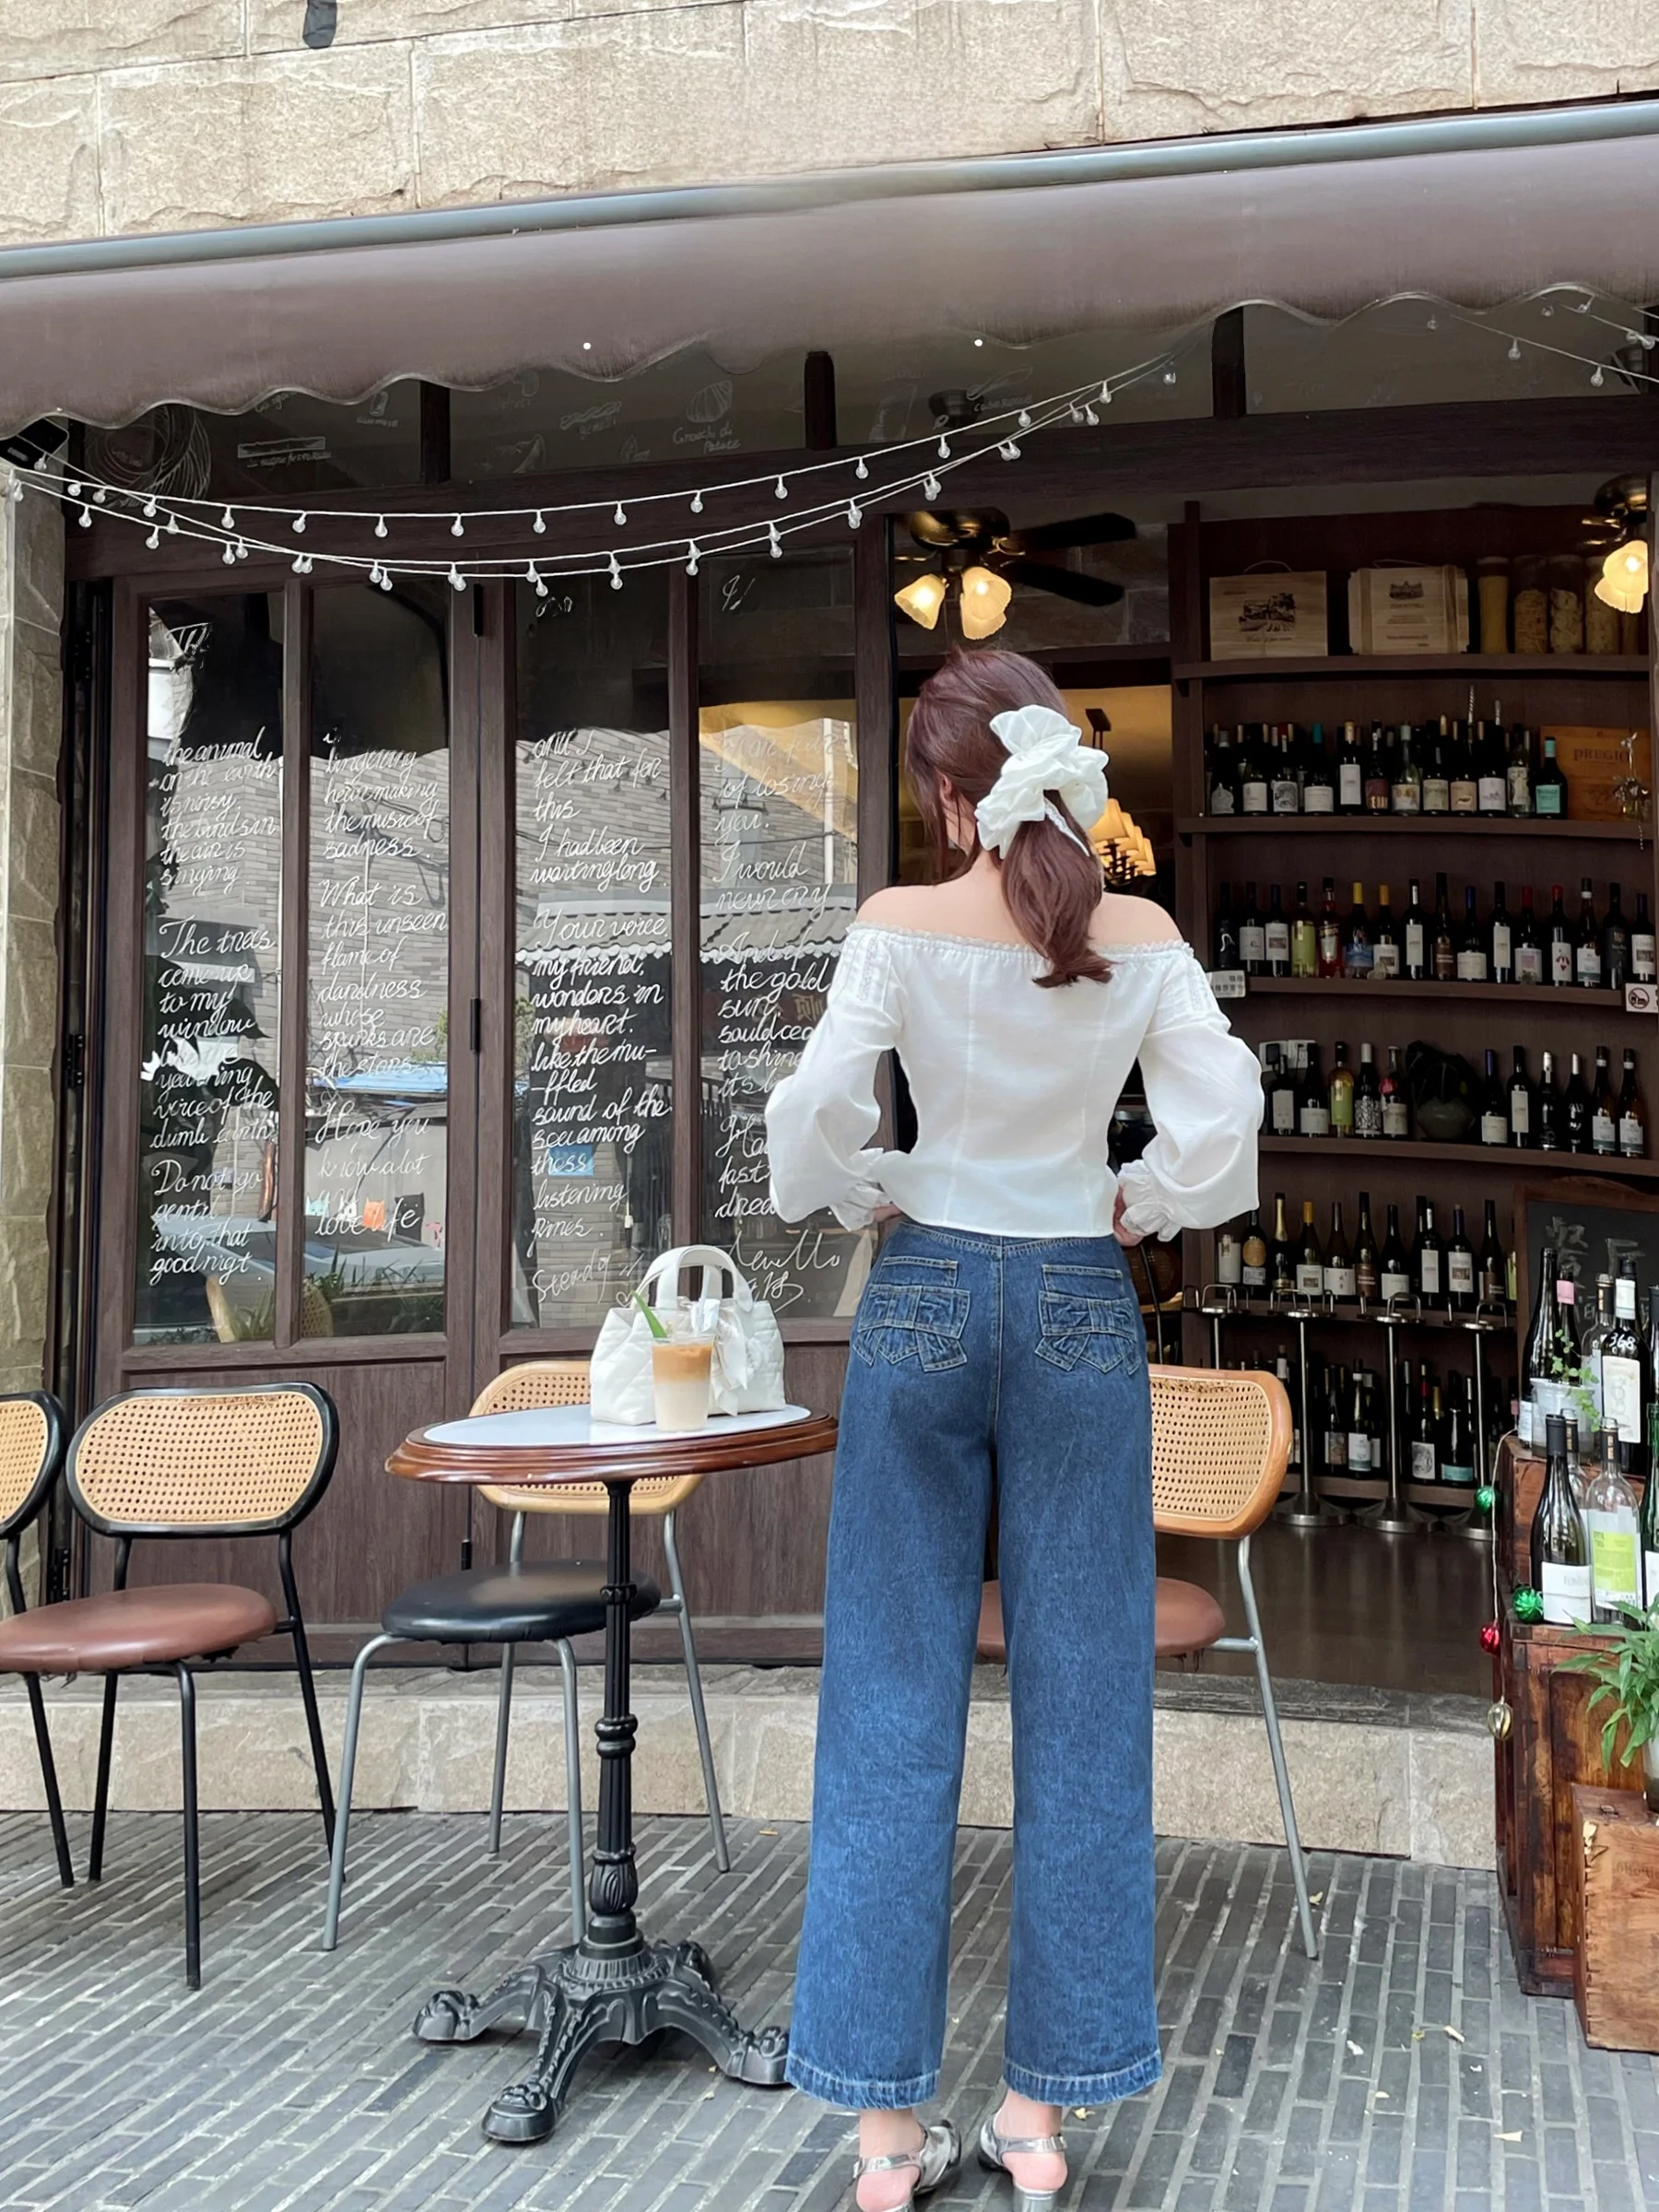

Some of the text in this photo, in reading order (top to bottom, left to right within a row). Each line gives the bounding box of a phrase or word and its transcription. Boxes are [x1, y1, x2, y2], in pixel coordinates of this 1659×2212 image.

[533, 791, 582, 822] this
[318, 875, 423, 907] What is
[159, 914, 213, 959] The
[321, 910, 370, 939] this
[151, 1159, 193, 1195] Do
[1608, 1333, 1637, 1350] 368
